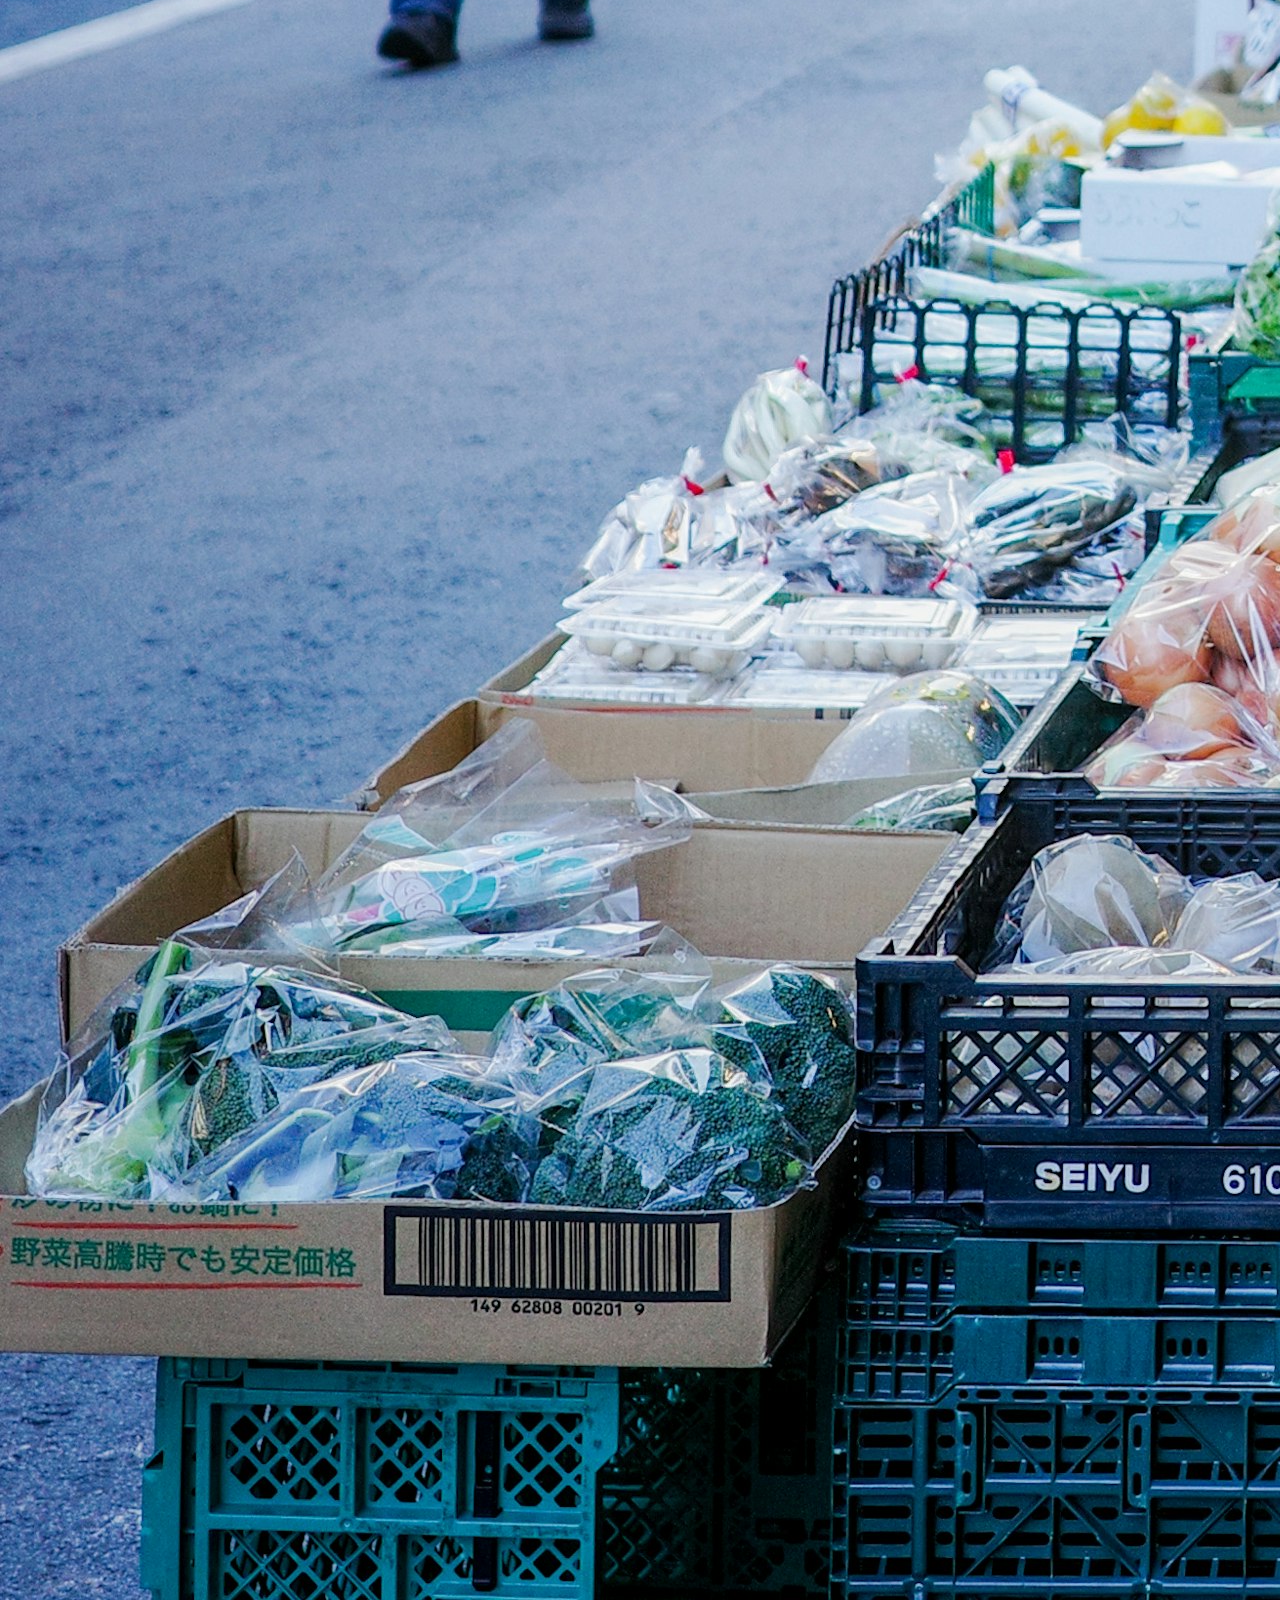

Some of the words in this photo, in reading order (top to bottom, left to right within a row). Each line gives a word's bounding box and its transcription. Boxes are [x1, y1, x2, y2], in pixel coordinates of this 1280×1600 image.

[1034, 1161, 1150, 1194] SEIYU
[10, 1236, 357, 1280] 野菜高騰時でも安定価格
[470, 1298, 501, 1313] 149
[511, 1300, 562, 1315] 62808
[572, 1301, 622, 1317] 00201
[634, 1303, 645, 1316] 9
